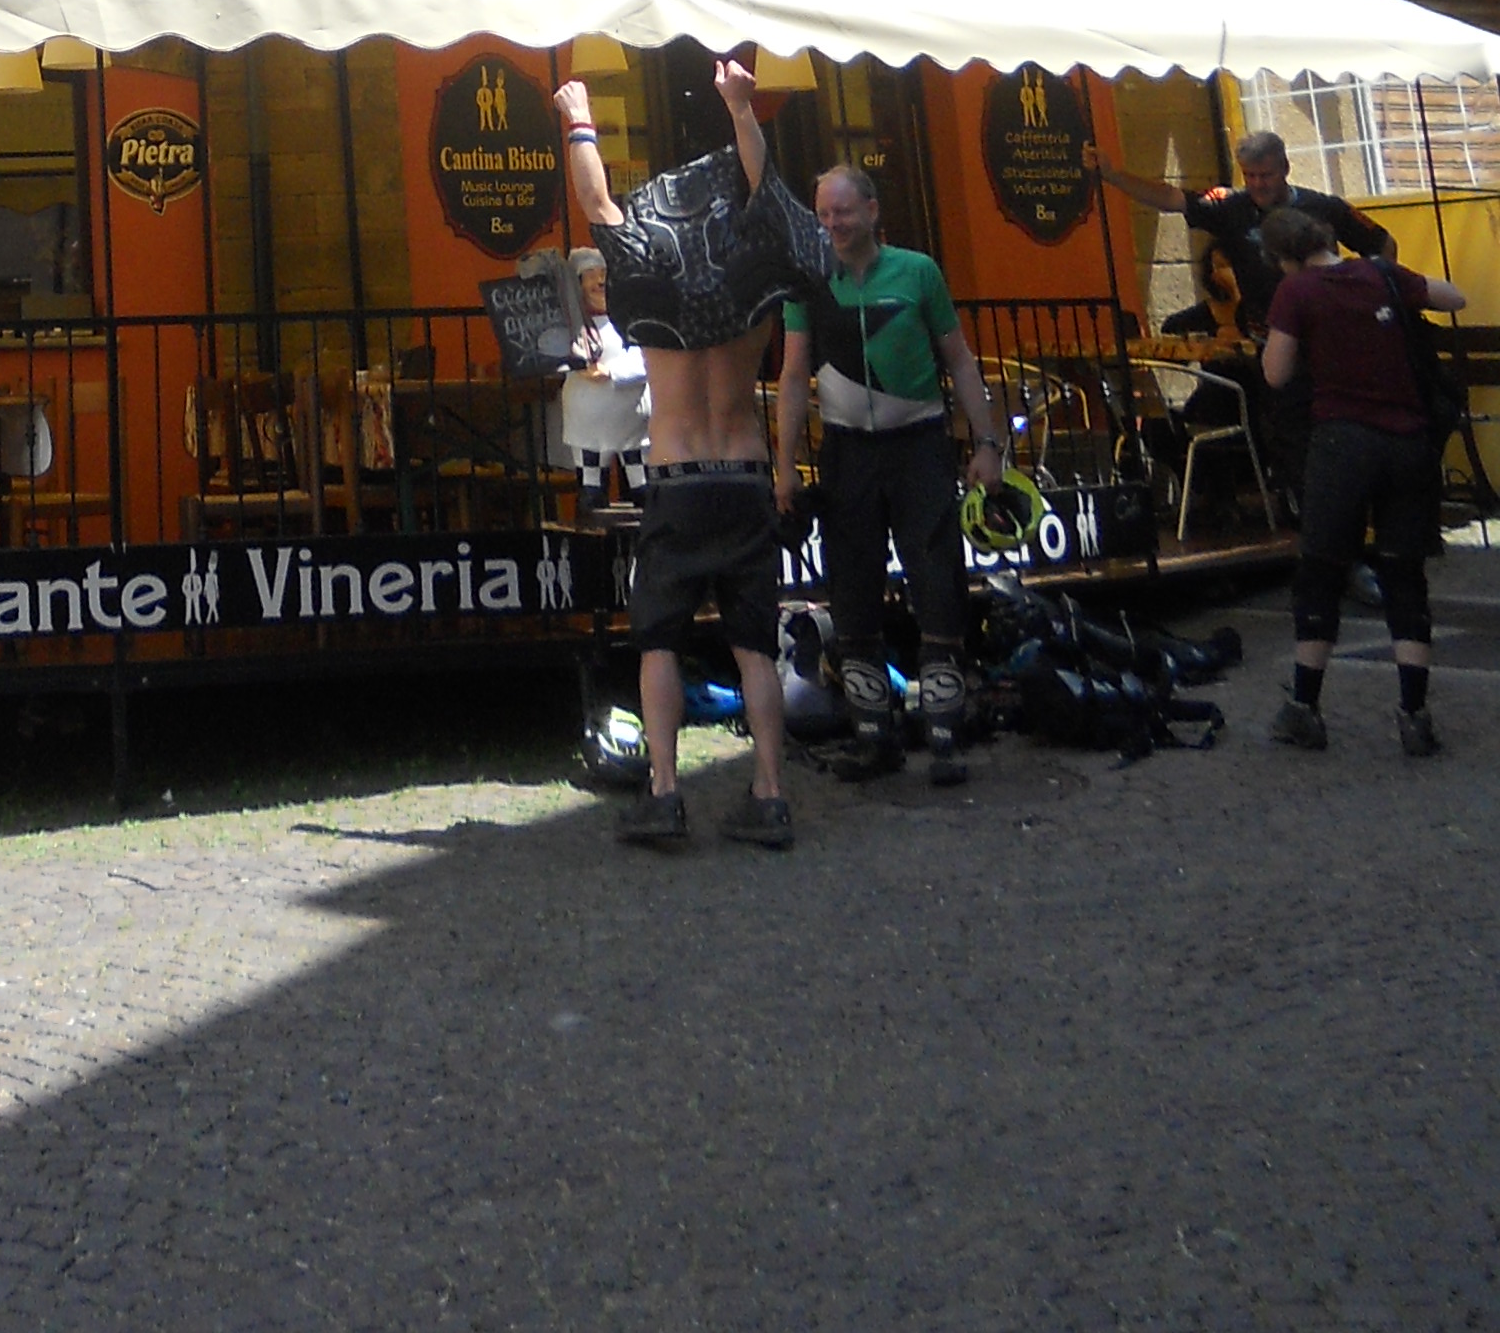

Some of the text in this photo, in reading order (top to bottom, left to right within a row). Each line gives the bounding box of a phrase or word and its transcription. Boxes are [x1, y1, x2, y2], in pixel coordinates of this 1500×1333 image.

[120, 139, 195, 166] Pietra
[440, 145, 556, 171] Cantina Bistrò
[461, 180, 535, 195] Music Lounge
[462, 193, 502, 206] Cuisine
[517, 194, 535, 206] Bar
[245, 543, 522, 619] Vineria
